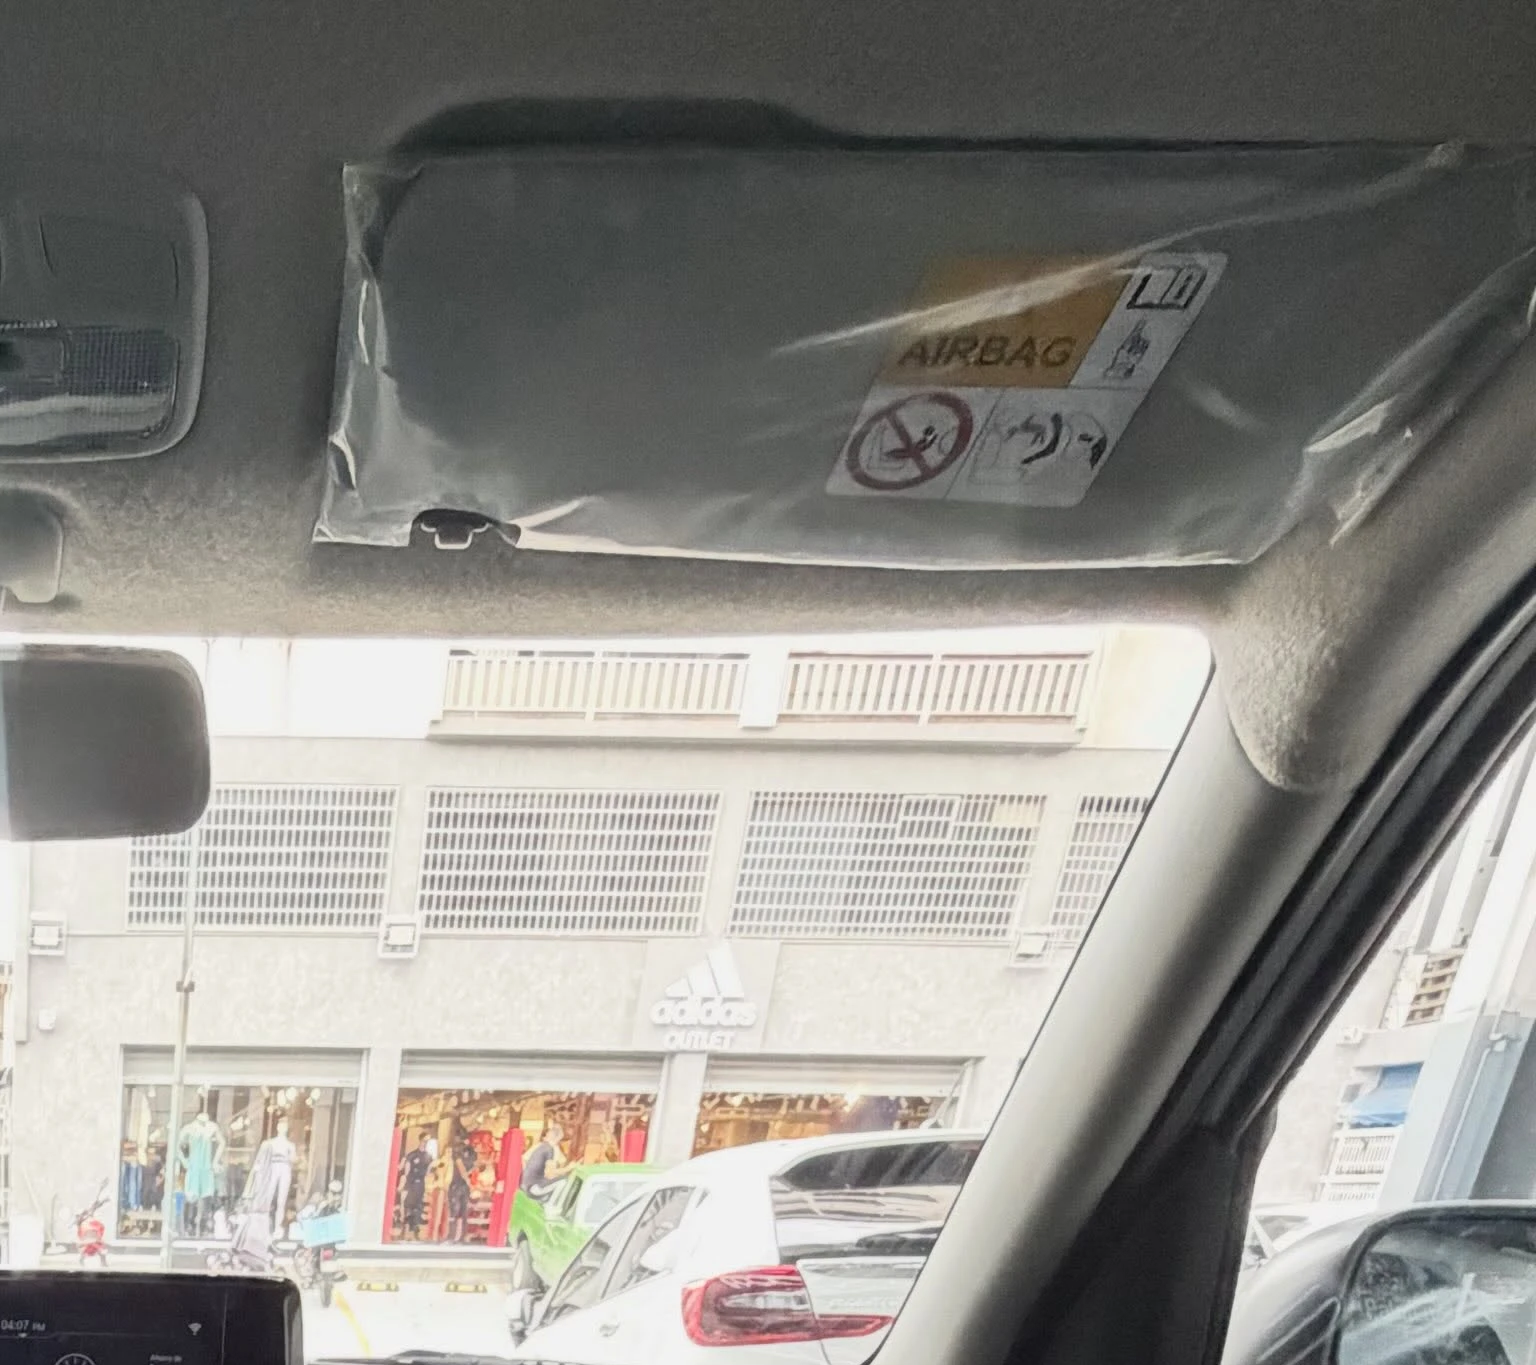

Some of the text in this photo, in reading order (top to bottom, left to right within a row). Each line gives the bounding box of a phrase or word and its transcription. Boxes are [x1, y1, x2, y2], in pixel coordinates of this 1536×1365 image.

[898, 335, 1077, 367] AIRBAG
[650, 996, 757, 1026] adidas
[664, 1030, 735, 1050] OUTLET
[1, 1320, 30, 1331] 04:07
